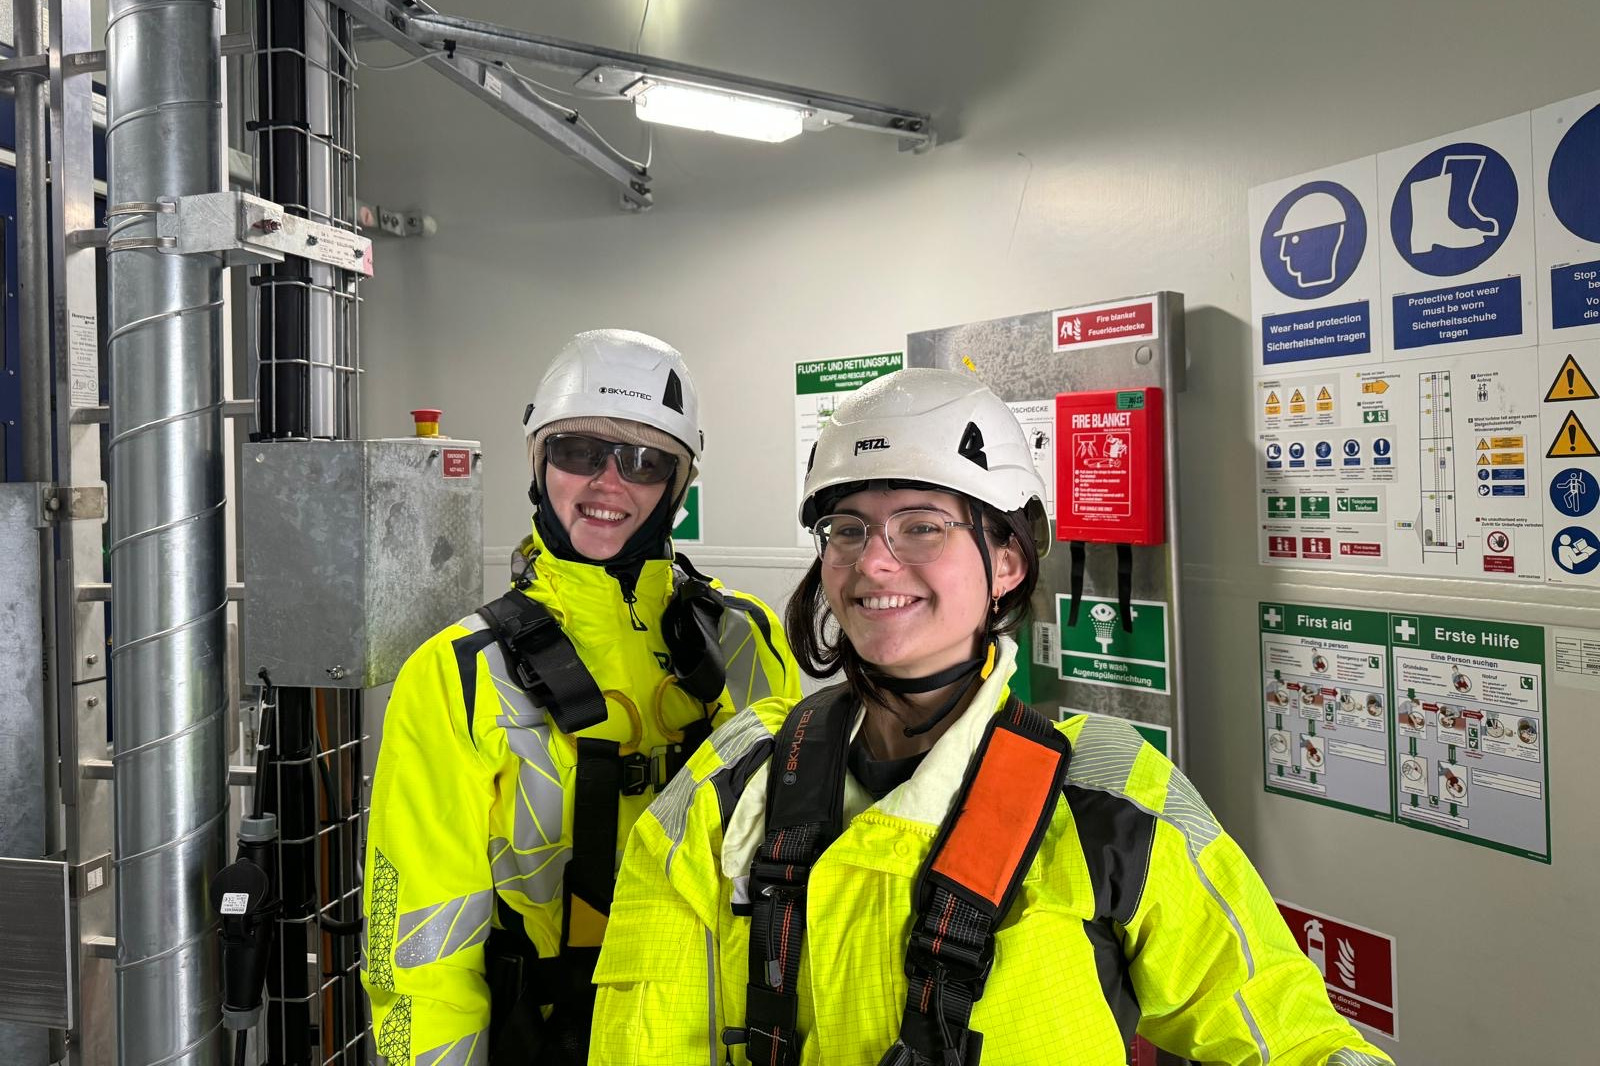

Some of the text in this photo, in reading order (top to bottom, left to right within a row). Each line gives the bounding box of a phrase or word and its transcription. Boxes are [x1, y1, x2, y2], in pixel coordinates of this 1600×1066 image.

[1574, 271, 1597, 281] Stop
[1408, 286, 1500, 306] Protective foot wear
[1422, 301, 1484, 316] must be worn
[1096, 312, 1136, 324] Fire blanket
[1270, 314, 1362, 334] Wear head protection
[1412, 312, 1497, 330] Sicherheitsschuhe
[1088, 322, 1145, 336] Feuerlöschdecke
[1439, 328, 1468, 339] tragen
[1266, 332, 1366, 352] Sicherheitshelm tragen
[798, 356, 901, 374] FLUCHT- UND RETTUNGSPLAN
[608, 388, 652, 400] SKYLOTEC
[1072, 412, 1132, 428] FIRE BLANKET
[854, 438, 890, 456] PETZL
[1297, 614, 1352, 631] First aid
[1301, 639, 1322, 648] Finding
[1328, 643, 1348, 651] person
[1434, 627, 1520, 649] Erste Hilfe
[1094, 660, 1128, 672] Eye wash
[1431, 653, 1498, 668] Eine Person suchen
[1073, 668, 1152, 686] Augenspüleinrichtung
[786, 710, 814, 772] SKYLOTEC
